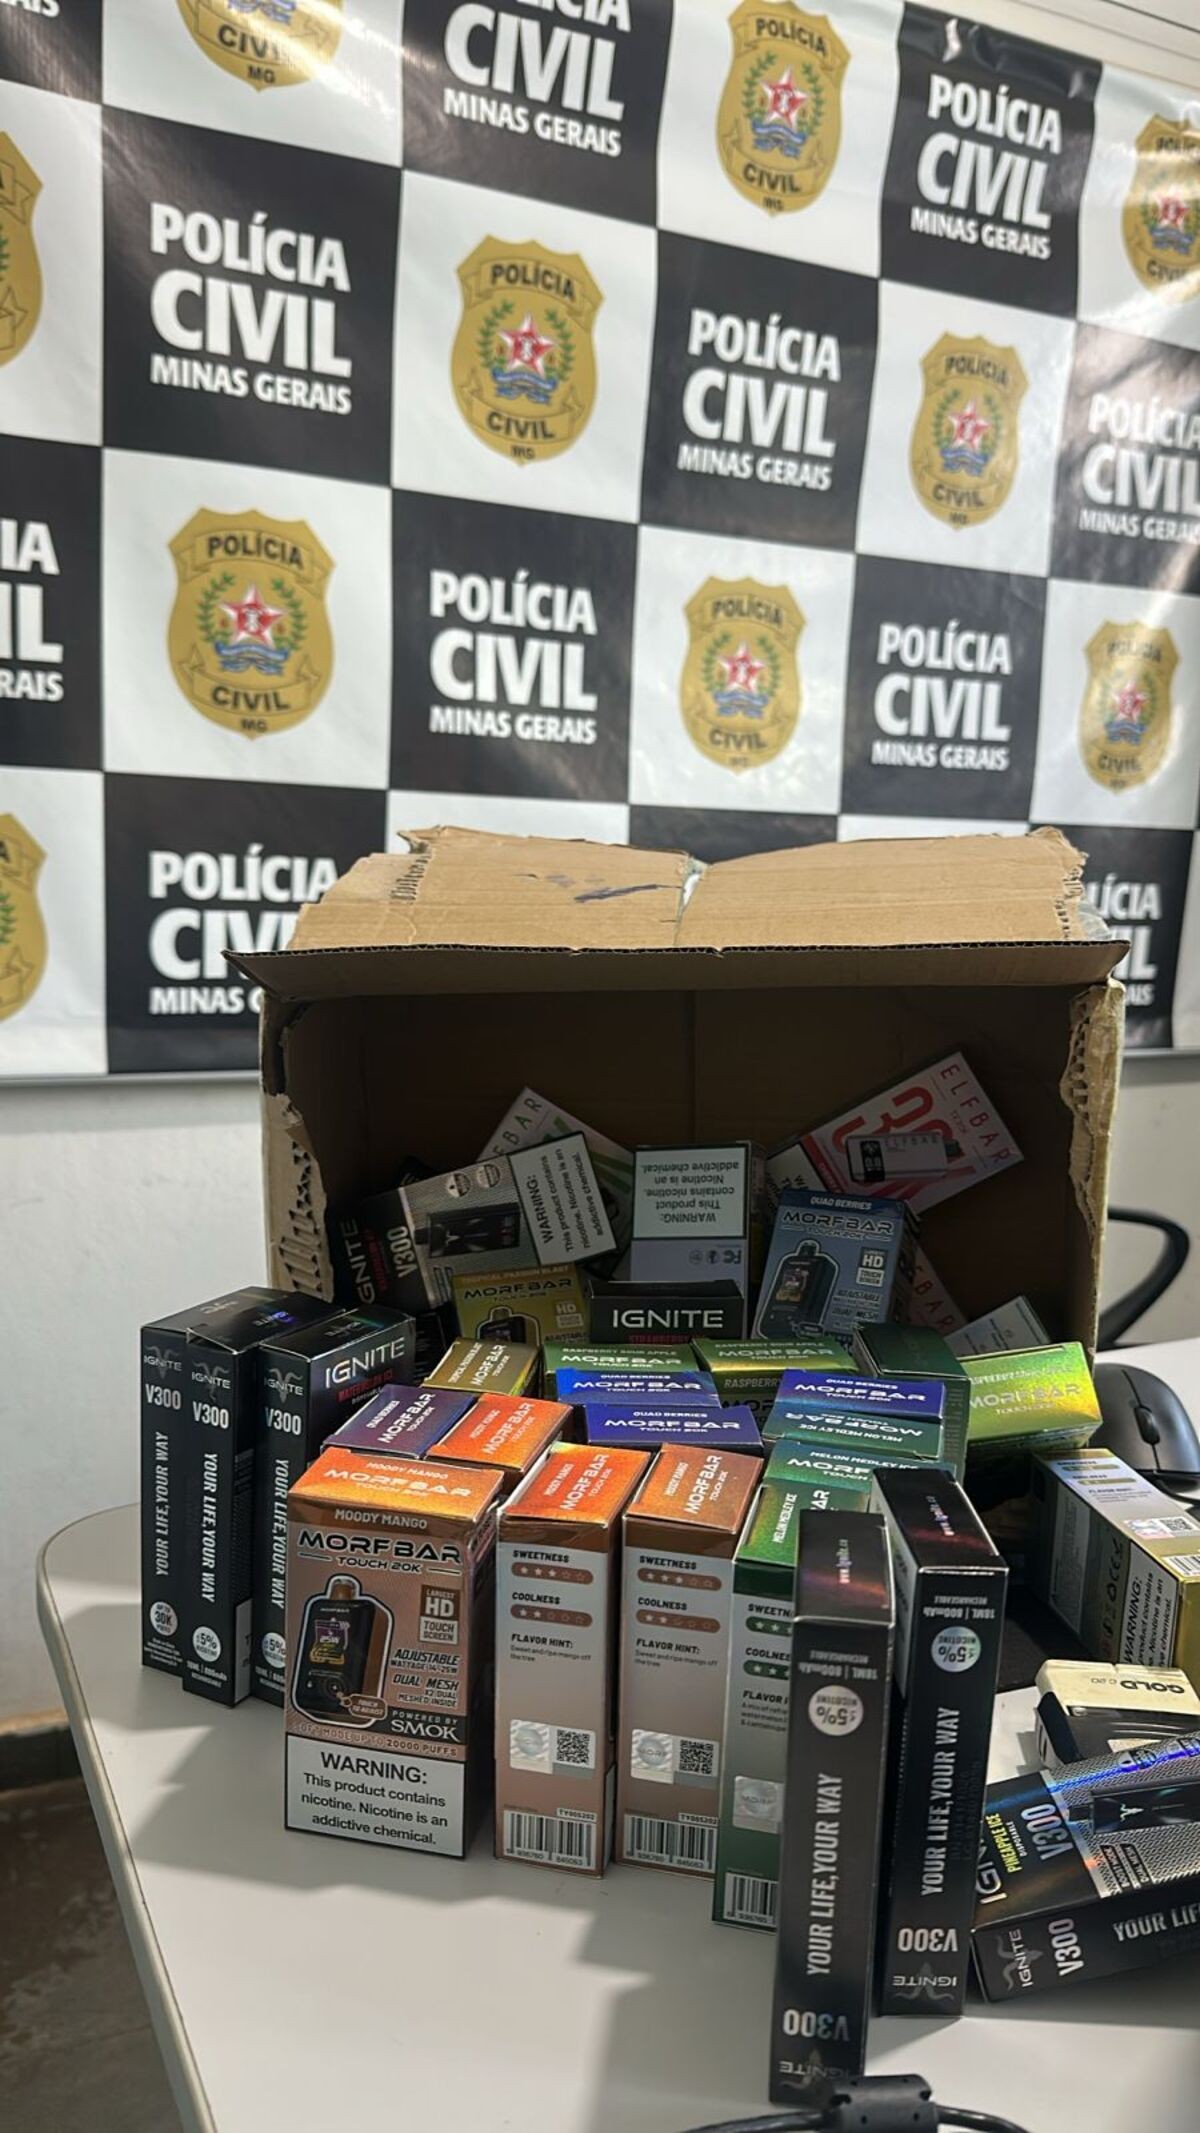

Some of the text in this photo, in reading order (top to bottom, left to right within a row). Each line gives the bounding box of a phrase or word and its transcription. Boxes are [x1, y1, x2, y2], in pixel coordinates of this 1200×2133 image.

[756, 18, 827, 57] POLÍCIA
[247, 65, 276, 85] MG
[444, 4, 624, 121] CIVIL
[444, 88, 621, 156] MINAS GERAIS
[928, 74, 1062, 154] POLÍCIA
[744, 163, 801, 194] CIVIL
[917, 132, 1051, 229] CIVIL
[151, 203, 351, 292] POLÍCIA
[910, 207, 1051, 260] MINAS GERAIS
[490, 260, 575, 301] POLÍCIA
[151, 269, 352, 377] CIVIL
[688, 308, 842, 382] POLÍCIA
[150, 354, 352, 415] MINAS GERAIS
[946, 356, 1008, 385] POLÍCIA
[487, 411, 556, 440] CIVIL
[683, 368, 836, 457] CIVIL
[677, 444, 832, 491] MINAS GERAIS
[1082, 443, 1200, 517] CIVIL
[933, 484, 984, 508] CIVIL
[1079, 509, 1141, 537] MINAS
[207, 533, 304, 571] POLÍCIA
[430, 568, 597, 635] POLÍCIA
[711, 594, 785, 628] POLÍCIA
[876, 618, 1012, 675] POLÍCIA
[430, 628, 598, 711] CIVIL
[211, 684, 291, 713] CIVIL
[873, 673, 1012, 742] CIVIL
[430, 705, 597, 746] MINAS GERAIS
[708, 727, 769, 751] CIVIL
[871, 741, 1009, 772] MINAS GERAIS
[149, 843, 338, 903] POLÍCIA
[149, 986, 245, 1015] MINAS
[940, 1064, 1017, 1163] ELFBAR
[682, 1175, 724, 1184] Nicotine
[692, 1162, 740, 1172] addictive
[542, 1155, 573, 1251] This product contains
[562, 1172, 578, 1209] Nicotine
[656, 1199, 720, 1210] This product
[690, 1187, 735, 1196] contains
[527, 1174, 553, 1244] WARNING:
[783, 1211, 893, 1234] MORFBAR
[387, 1226, 417, 1278] V300
[862, 1254, 884, 1268] HD
[612, 1309, 724, 1328] IGNITE
[144, 1354, 182, 1372] IGNITE
[325, 1337, 405, 1389] IGNITE
[191, 1370, 231, 1390] IGNITE
[265, 1377, 304, 1396] IGNITE
[826, 1378, 854, 1386] QUAD
[145, 1383, 182, 1410] V300
[192, 1401, 230, 1430] V300
[265, 1406, 301, 1436] V300
[155, 1432, 169, 1462] WAY
[809, 1451, 896, 1468] MELON MEDLEY
[203, 1453, 218, 1493] YOUR
[274, 1459, 289, 1500] YOUR
[366, 1462, 448, 1480] MOODY MANGO
[684, 1455, 722, 1514] MORFBAR
[335, 1509, 427, 1529] MOODY MANGO
[156, 1540, 169, 1577] YOUR
[298, 1530, 462, 1564] MORFBAR
[512, 1550, 570, 1563] SWEETNESS
[640, 1555, 697, 1570] SWEETNESS
[338, 1556, 421, 1573] TOUCH 20K
[201, 1569, 215, 1602] WAY
[271, 1574, 285, 1609] WAY
[512, 1592, 560, 1605] COOLNESS
[1142, 1572, 1154, 1619] contains
[154, 1611, 171, 1626] 30K
[425, 1598, 454, 1617] HD
[638, 1597, 687, 1610] COOLNESS
[1149, 1578, 1164, 1653] Nicotine an
[423, 1630, 454, 1641] SCREEN
[424, 1620, 454, 1633] TOUCH
[1124, 1577, 1142, 1664] WARNING:
[511, 1633, 574, 1649] FLAVOR HINT:
[636, 1639, 700, 1655] FLAVOR HINT:
[395, 1649, 459, 1667] ADJUSTABLE
[393, 1674, 459, 1691] DUAL MESH
[743, 1690, 782, 1704] FLAVOR
[1120, 1679, 1185, 1695] GOLD
[391, 1719, 461, 1743] SMOK
[392, 1710, 443, 1723] POWERED
[387, 1739, 457, 1757] 20000 PUFFS
[320, 1751, 427, 1784] WARNING:
[303, 1772, 446, 1808] This product contains
[816, 1773, 843, 1816] WAY
[921, 1847, 946, 1896] YOUR
[936, 1706, 960, 1745] WAY
[301, 1793, 448, 1827] nicotine. Nicotine is an
[985, 1813, 1000, 1829] ICE
[312, 1815, 436, 1845] addictive chemical.
[1021, 1803, 1073, 1861] V300
[991, 1827, 1023, 1874] PINEAPPLE
[897, 1928, 958, 1953] V300
[1112, 1910, 1168, 1942] YOUR
[806, 1923, 831, 1975] YOUR
[1008, 1929, 1033, 1988] IGNITE
[1049, 1917, 1085, 1977] V300
[892, 1974, 957, 1987] IGNITE
[783, 2009, 849, 2042] V300
